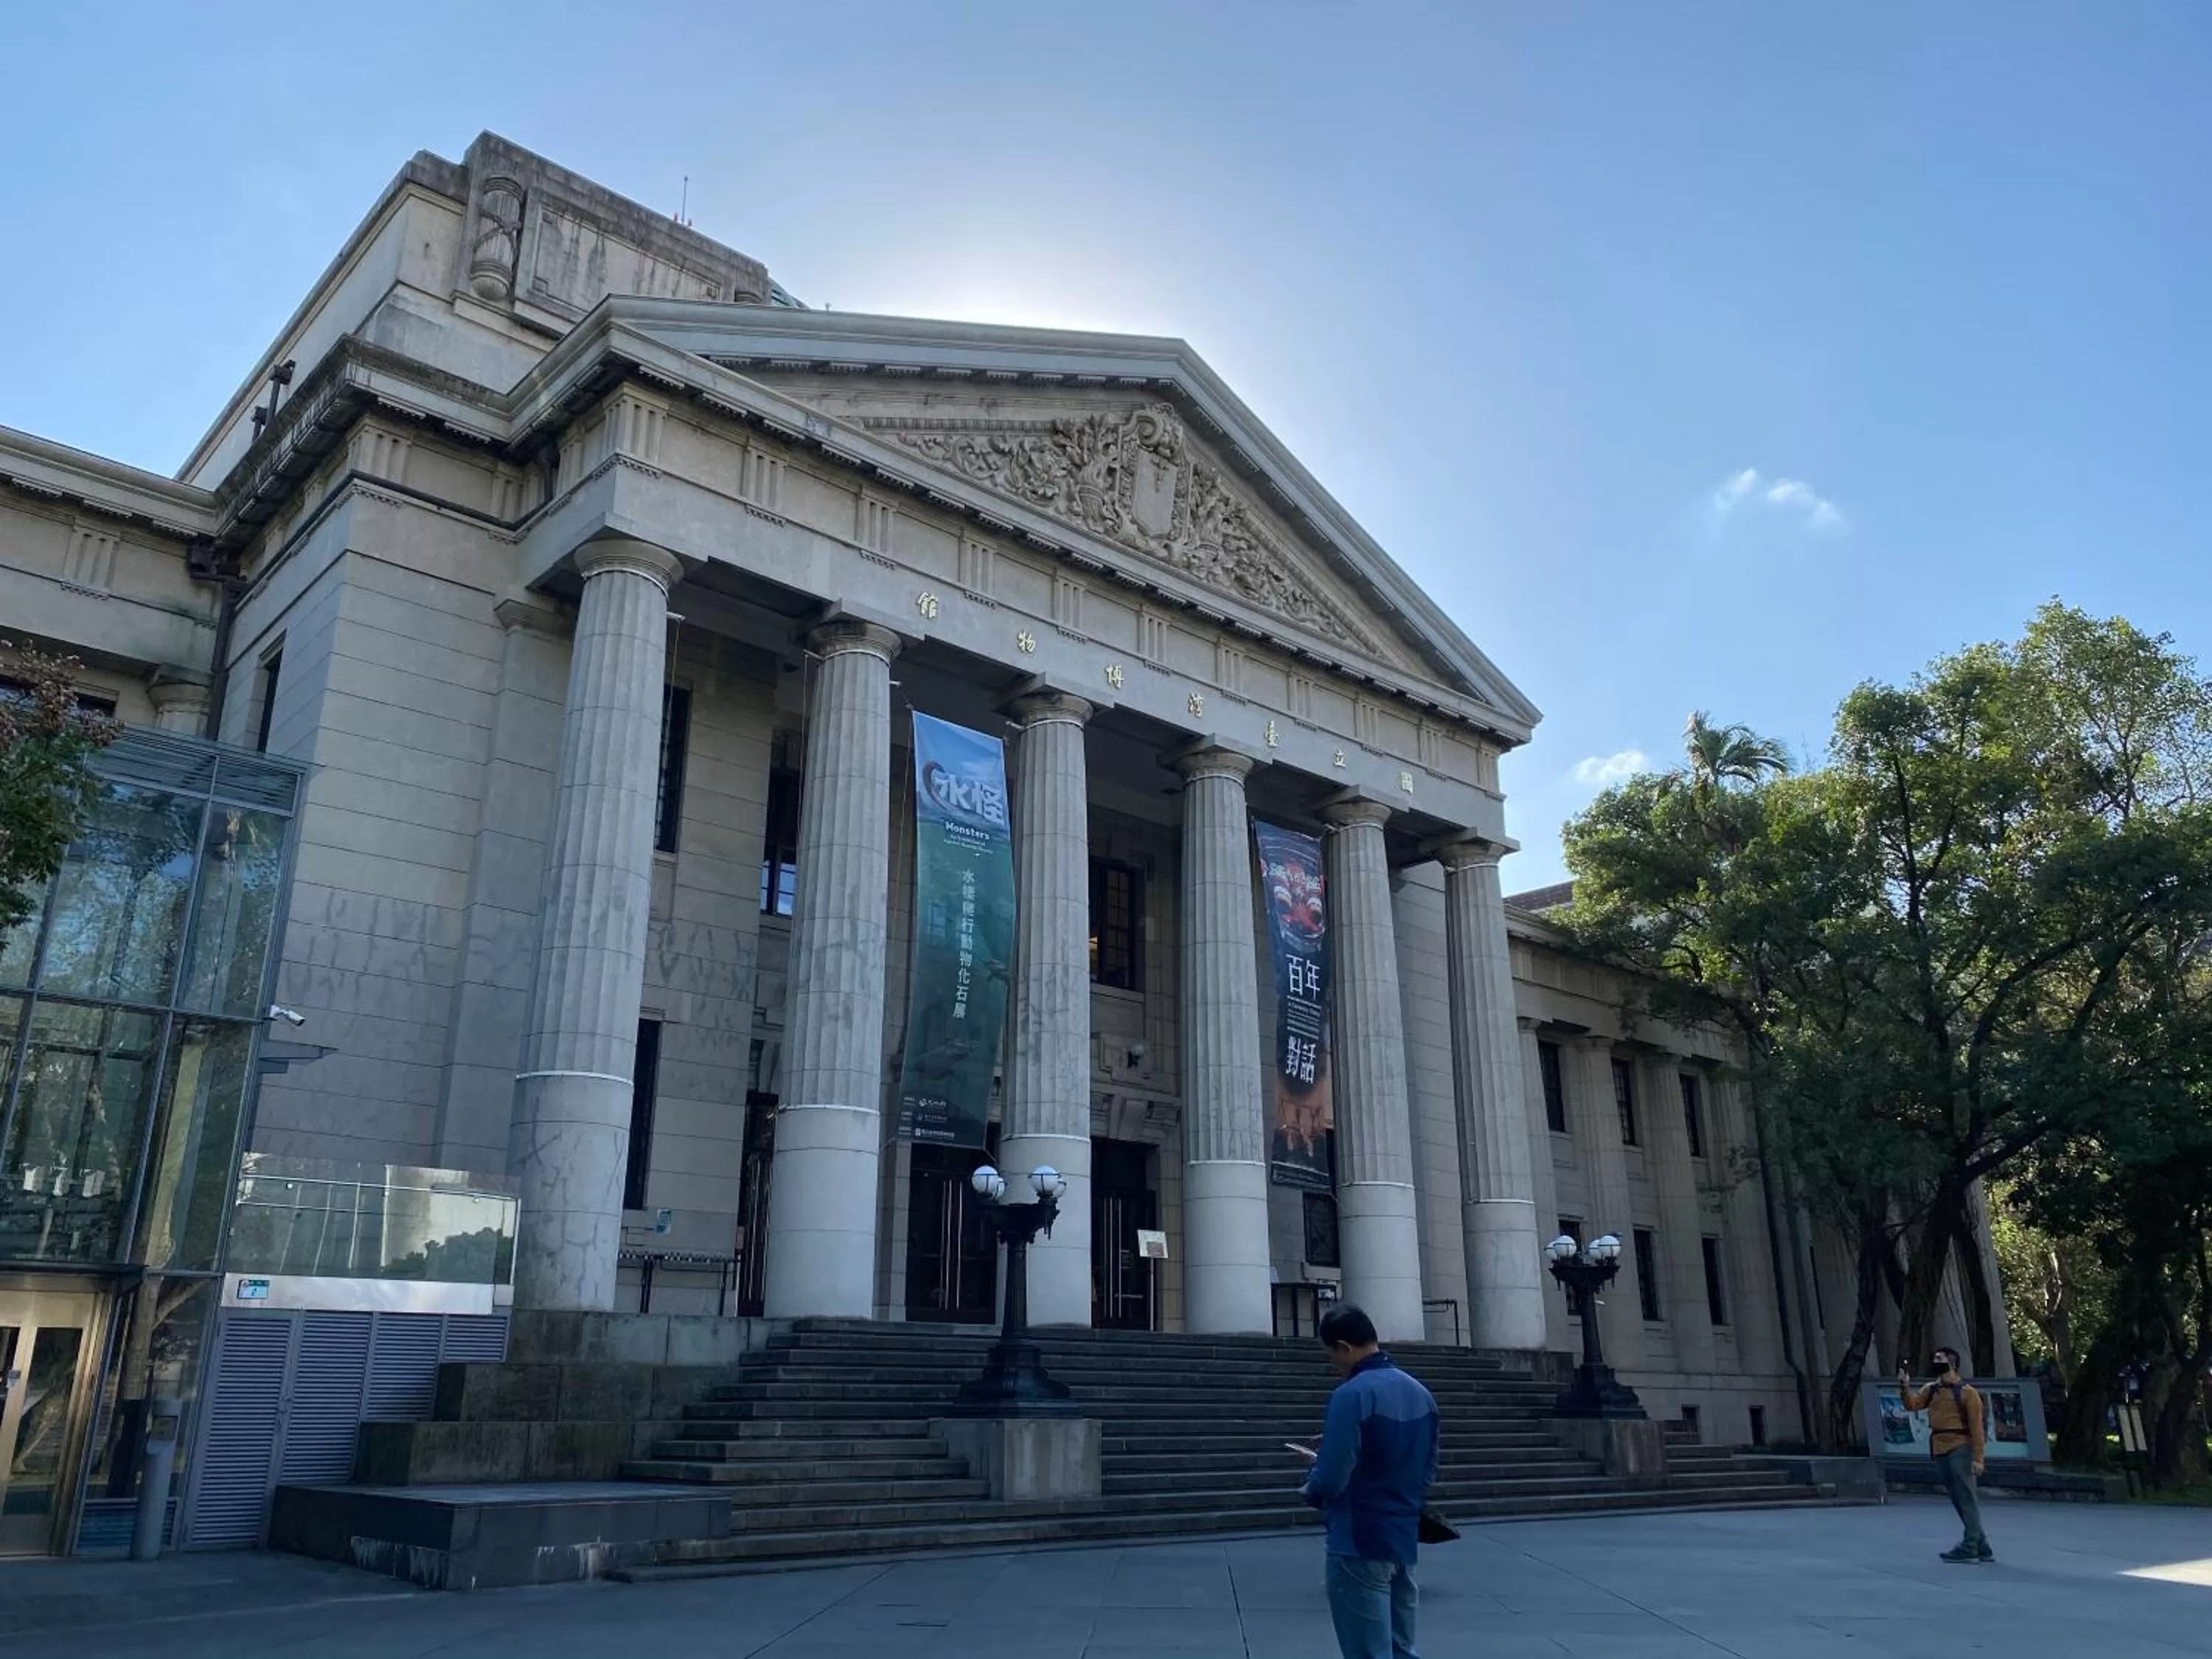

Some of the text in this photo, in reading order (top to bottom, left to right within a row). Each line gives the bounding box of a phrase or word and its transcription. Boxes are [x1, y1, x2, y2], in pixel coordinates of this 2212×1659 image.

[917, 591, 1413, 793] 國立臺灣博物館
[931, 769, 1004, 825] 水怪
[945, 821, 990, 840] Monsters
[1286, 953, 1321, 1000] 百年
[1285, 1035, 1316, 1084] 對話
